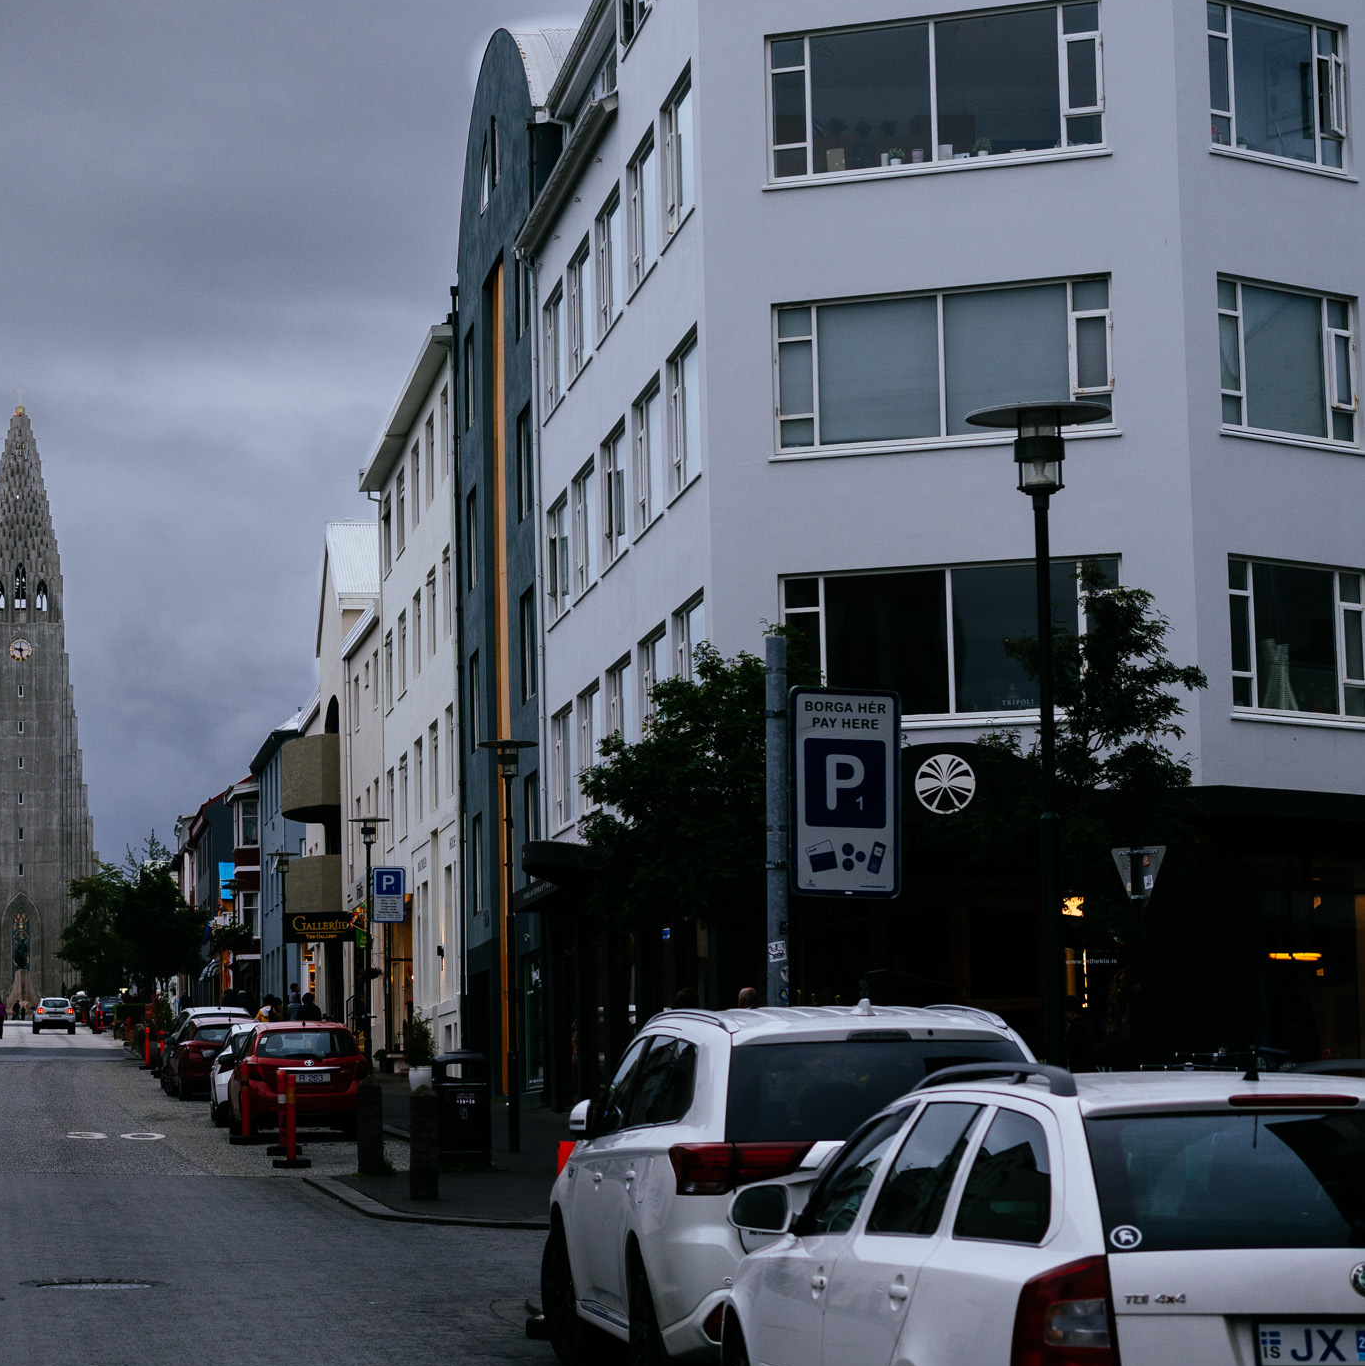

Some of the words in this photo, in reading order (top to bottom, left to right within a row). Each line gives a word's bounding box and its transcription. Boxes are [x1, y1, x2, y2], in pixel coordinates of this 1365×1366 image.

[804, 701, 853, 713] BORGA
[858, 701, 887, 714] HÉR
[812, 717, 837, 729] PAY
[841, 718, 879, 730] HERE
[825, 753, 865, 811] P
[855, 796, 864, 811] 1
[382, 875, 395, 891] P
[1264, 1346, 1280, 1359] IS
[1291, 1329, 1346, 1362] JX
